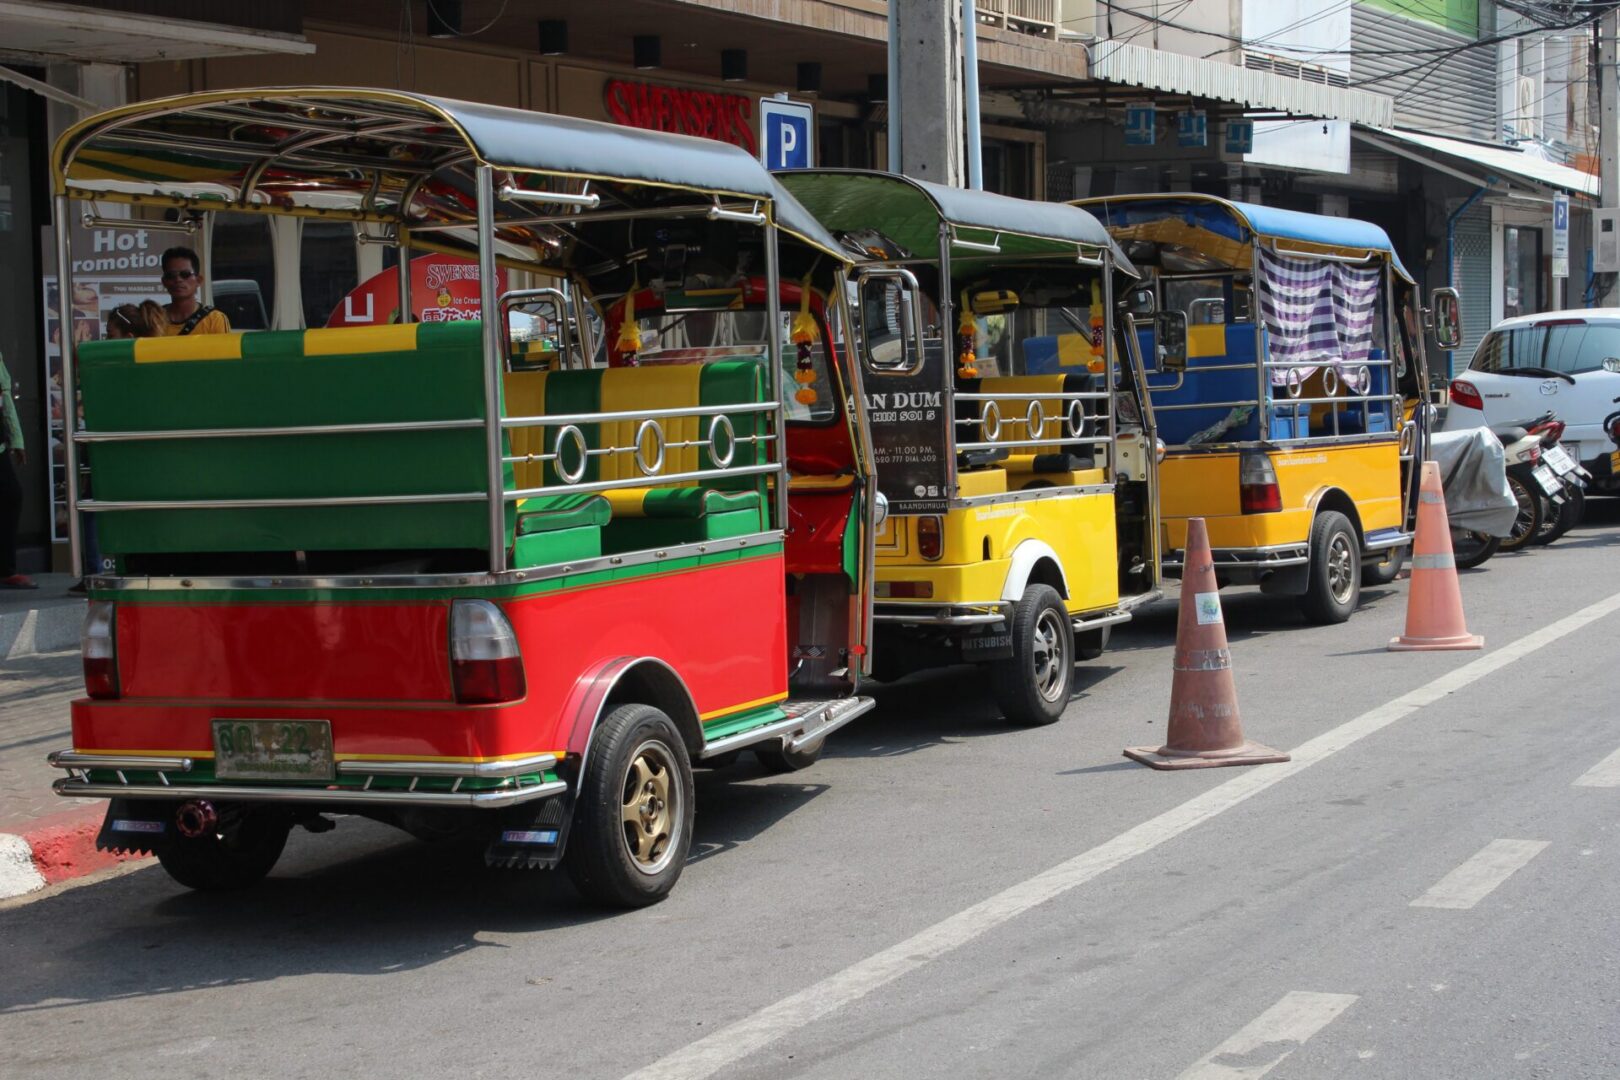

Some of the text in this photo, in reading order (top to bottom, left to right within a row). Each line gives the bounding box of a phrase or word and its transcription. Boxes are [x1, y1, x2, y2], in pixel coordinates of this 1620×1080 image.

[781, 123, 796, 167] P
[1558, 205, 1564, 226] P
[94, 229, 148, 252] Hot
[72, 252, 163, 273] romotio
[847, 391, 942, 410] AAN DUM
[873, 411, 897, 422] HIN
[899, 410, 923, 421] SOI
[895, 446, 917, 455] 11.00
[905, 455, 919, 463] DIAL
